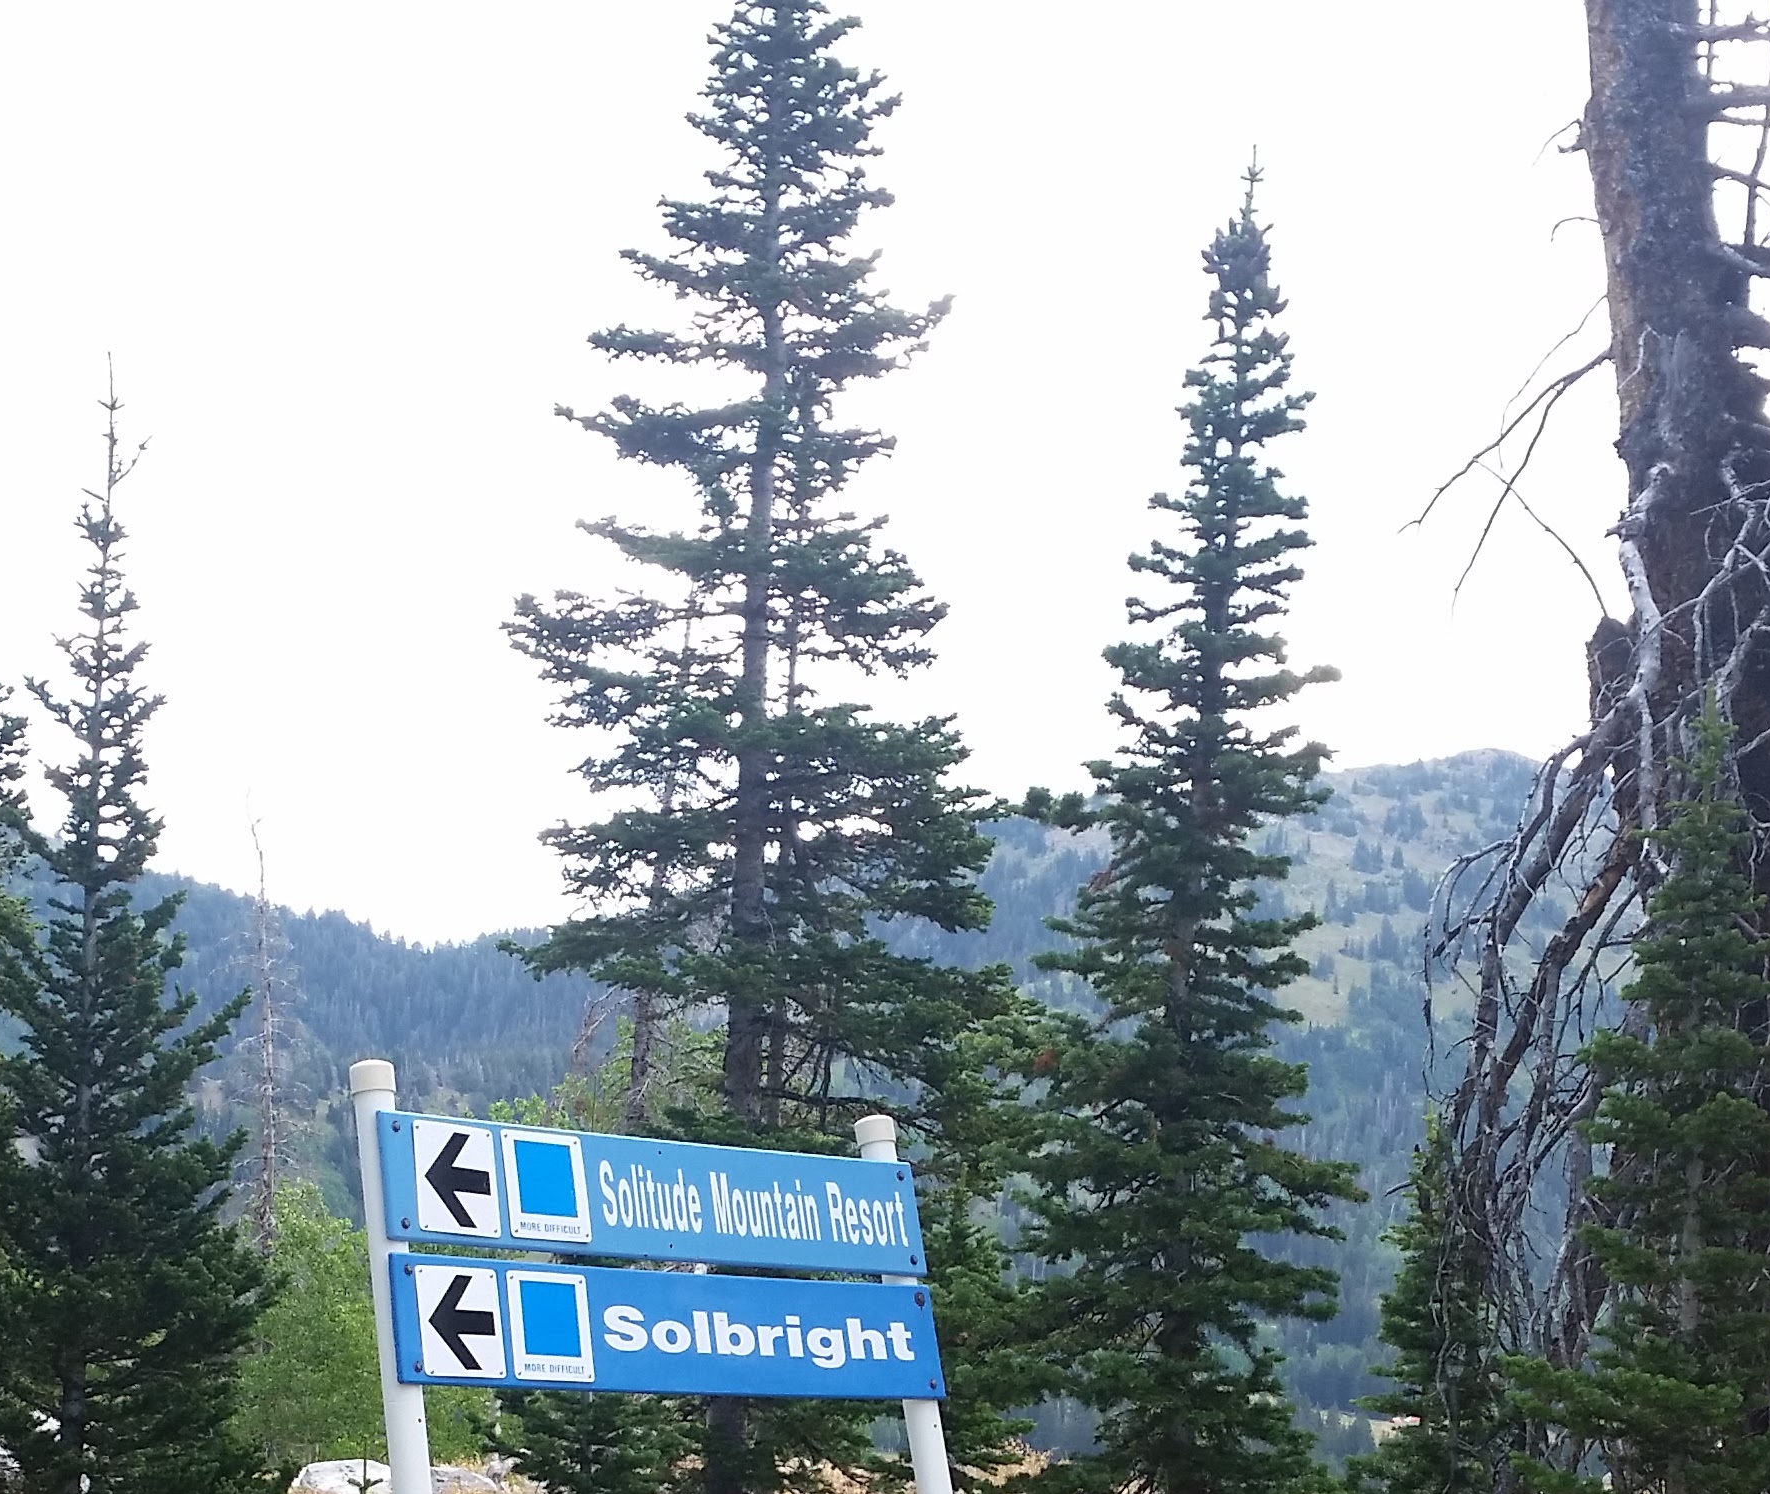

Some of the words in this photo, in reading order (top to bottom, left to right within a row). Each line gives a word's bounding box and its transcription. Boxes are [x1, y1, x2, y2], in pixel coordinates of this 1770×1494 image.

[598, 1159, 703, 1234] Solitude
[709, 1171, 821, 1241] Mountain
[826, 1181, 909, 1247] Resort
[520, 1221, 541, 1231] MORE
[544, 1223, 581, 1234] DIFFICULT
[603, 1305, 915, 1369] Solbright
[524, 1363, 545, 1373] MORE
[549, 1364, 585, 1374] DIFFICULT
